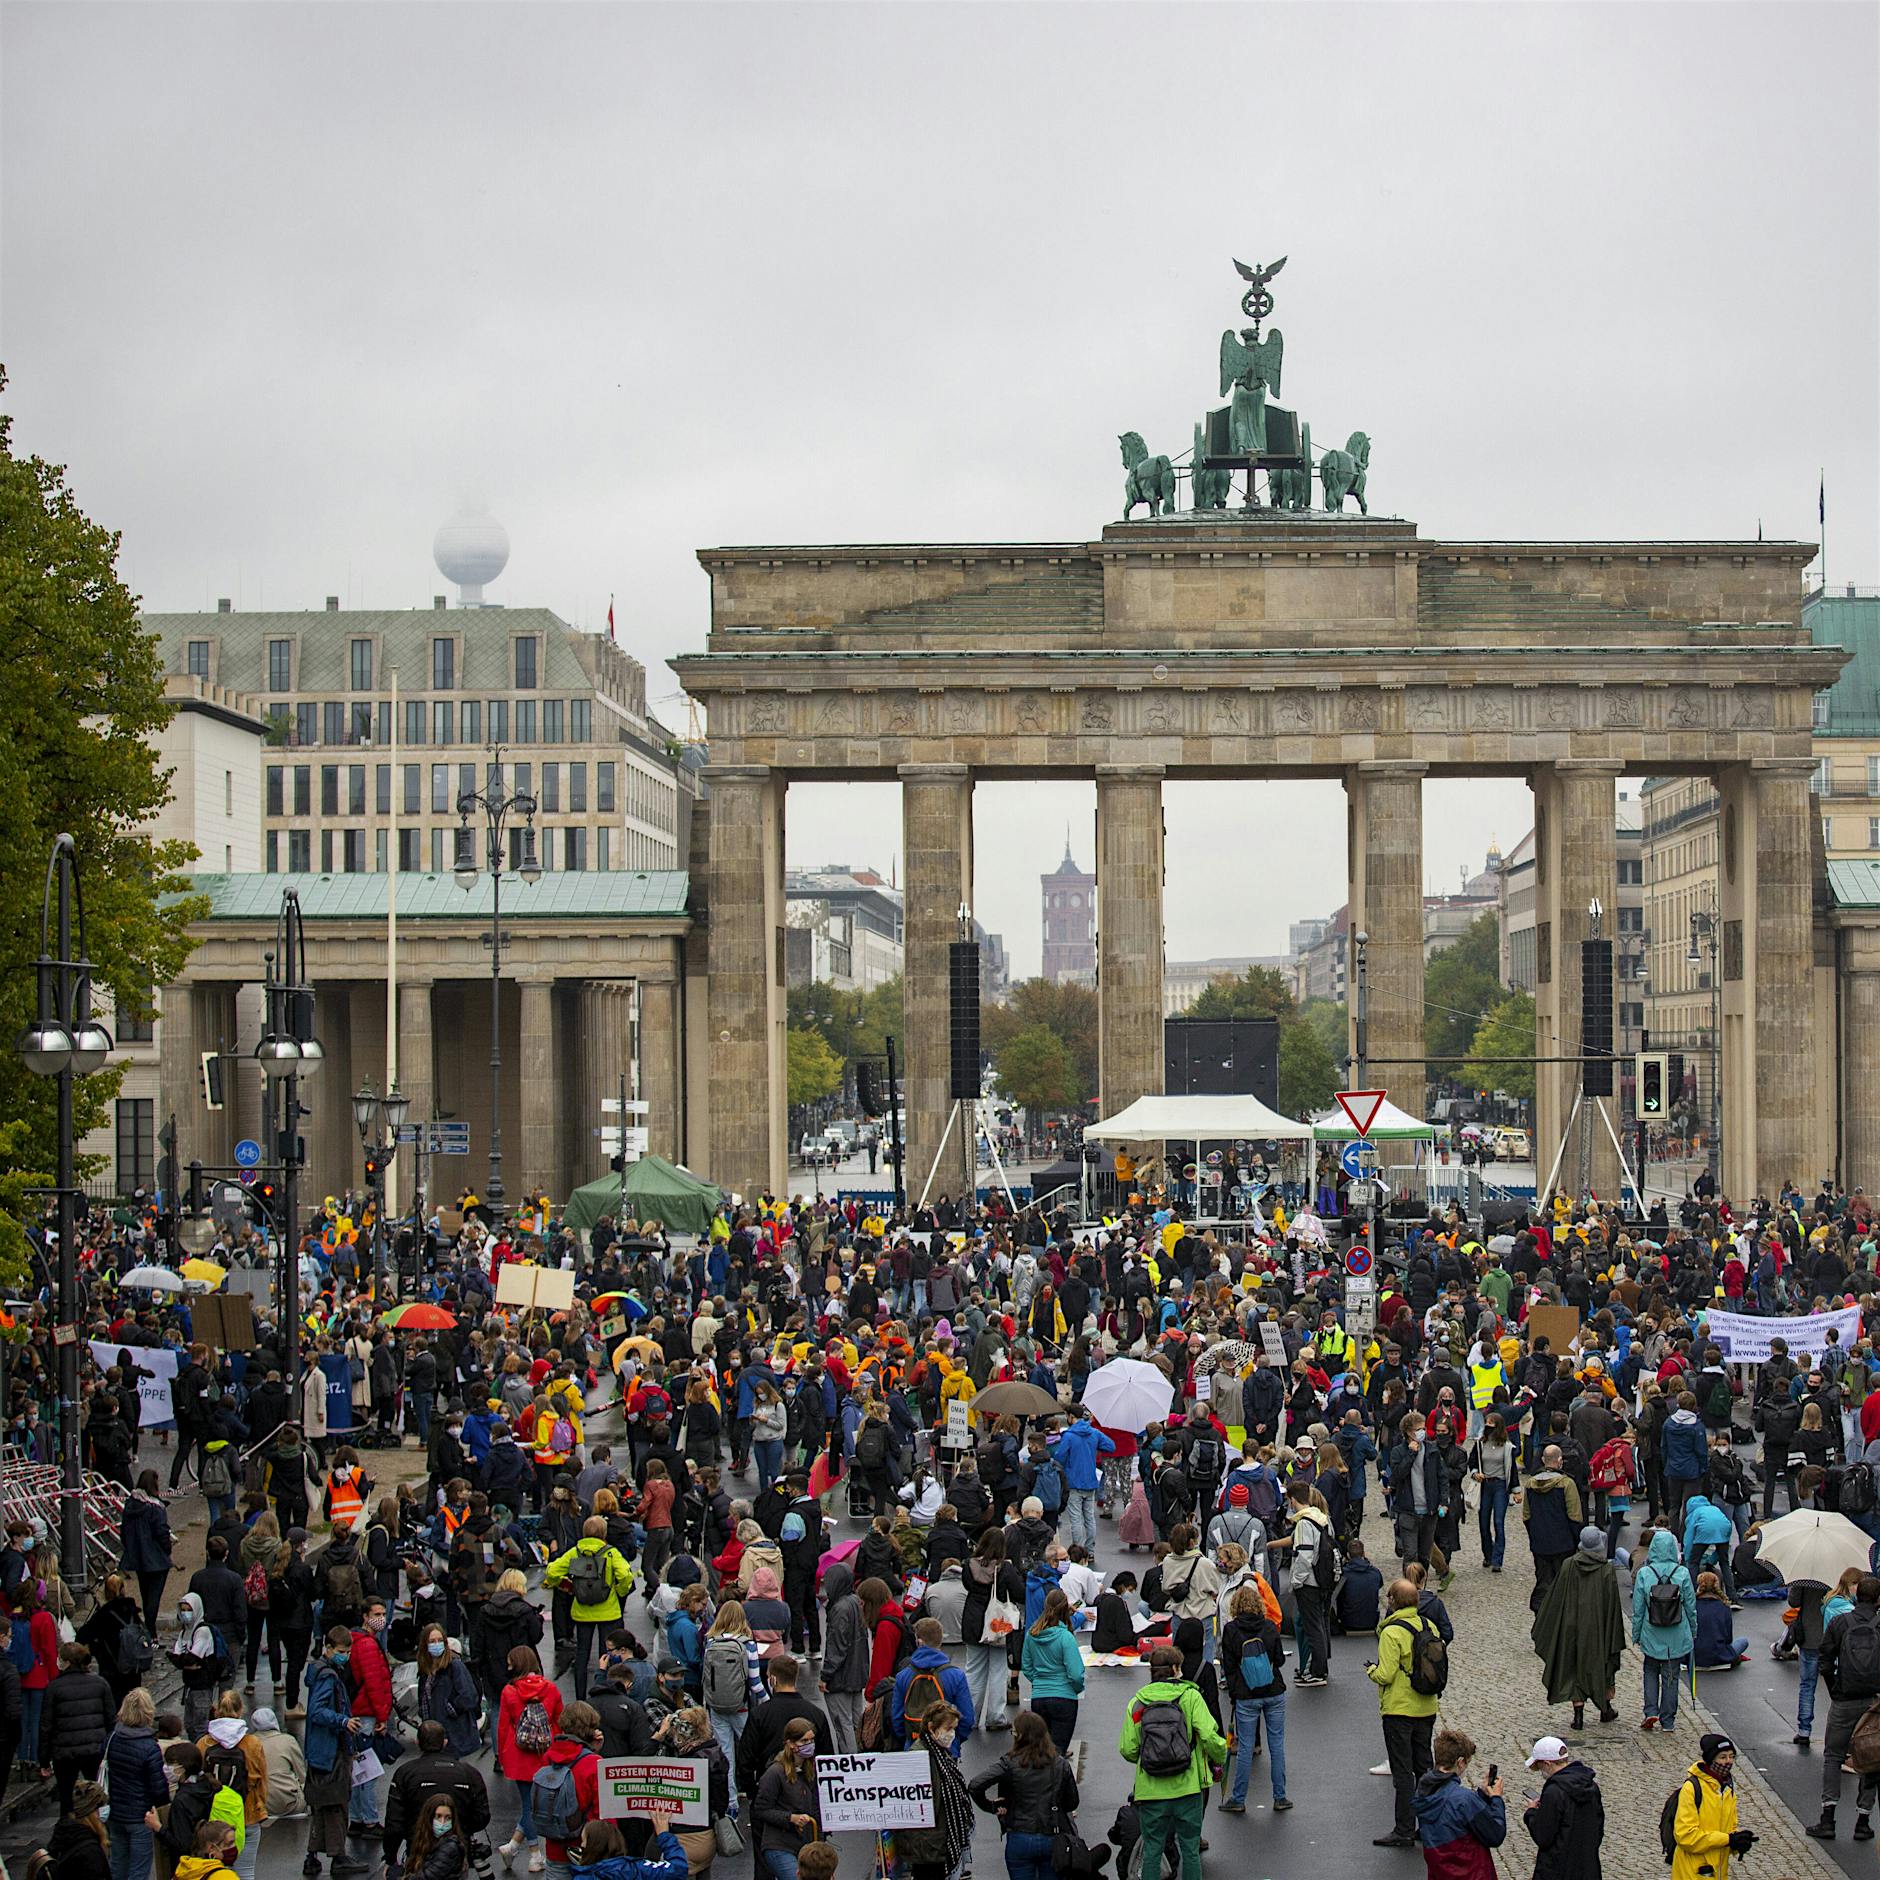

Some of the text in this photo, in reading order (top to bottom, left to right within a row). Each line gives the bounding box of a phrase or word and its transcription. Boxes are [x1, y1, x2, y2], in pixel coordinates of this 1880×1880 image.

[1710, 1314, 1721, 1322] Für
[1711, 1324, 1740, 1332] gerechte
[1734, 1338, 1752, 1346] Jetzt
[950, 1417, 965, 1425] GEGEN
[817, 1755, 876, 1772] mehr
[608, 1767, 692, 1779] SYSTEM CHANGE!
[617, 1784, 697, 1799] CLIMATE CHANGE!
[819, 1776, 932, 1808] Transparenz
[630, 1799, 647, 1808] DIE
[824, 1809, 833, 1821] in
[838, 1808, 851, 1822] der
[853, 1803, 915, 1828] Klimapolitik
